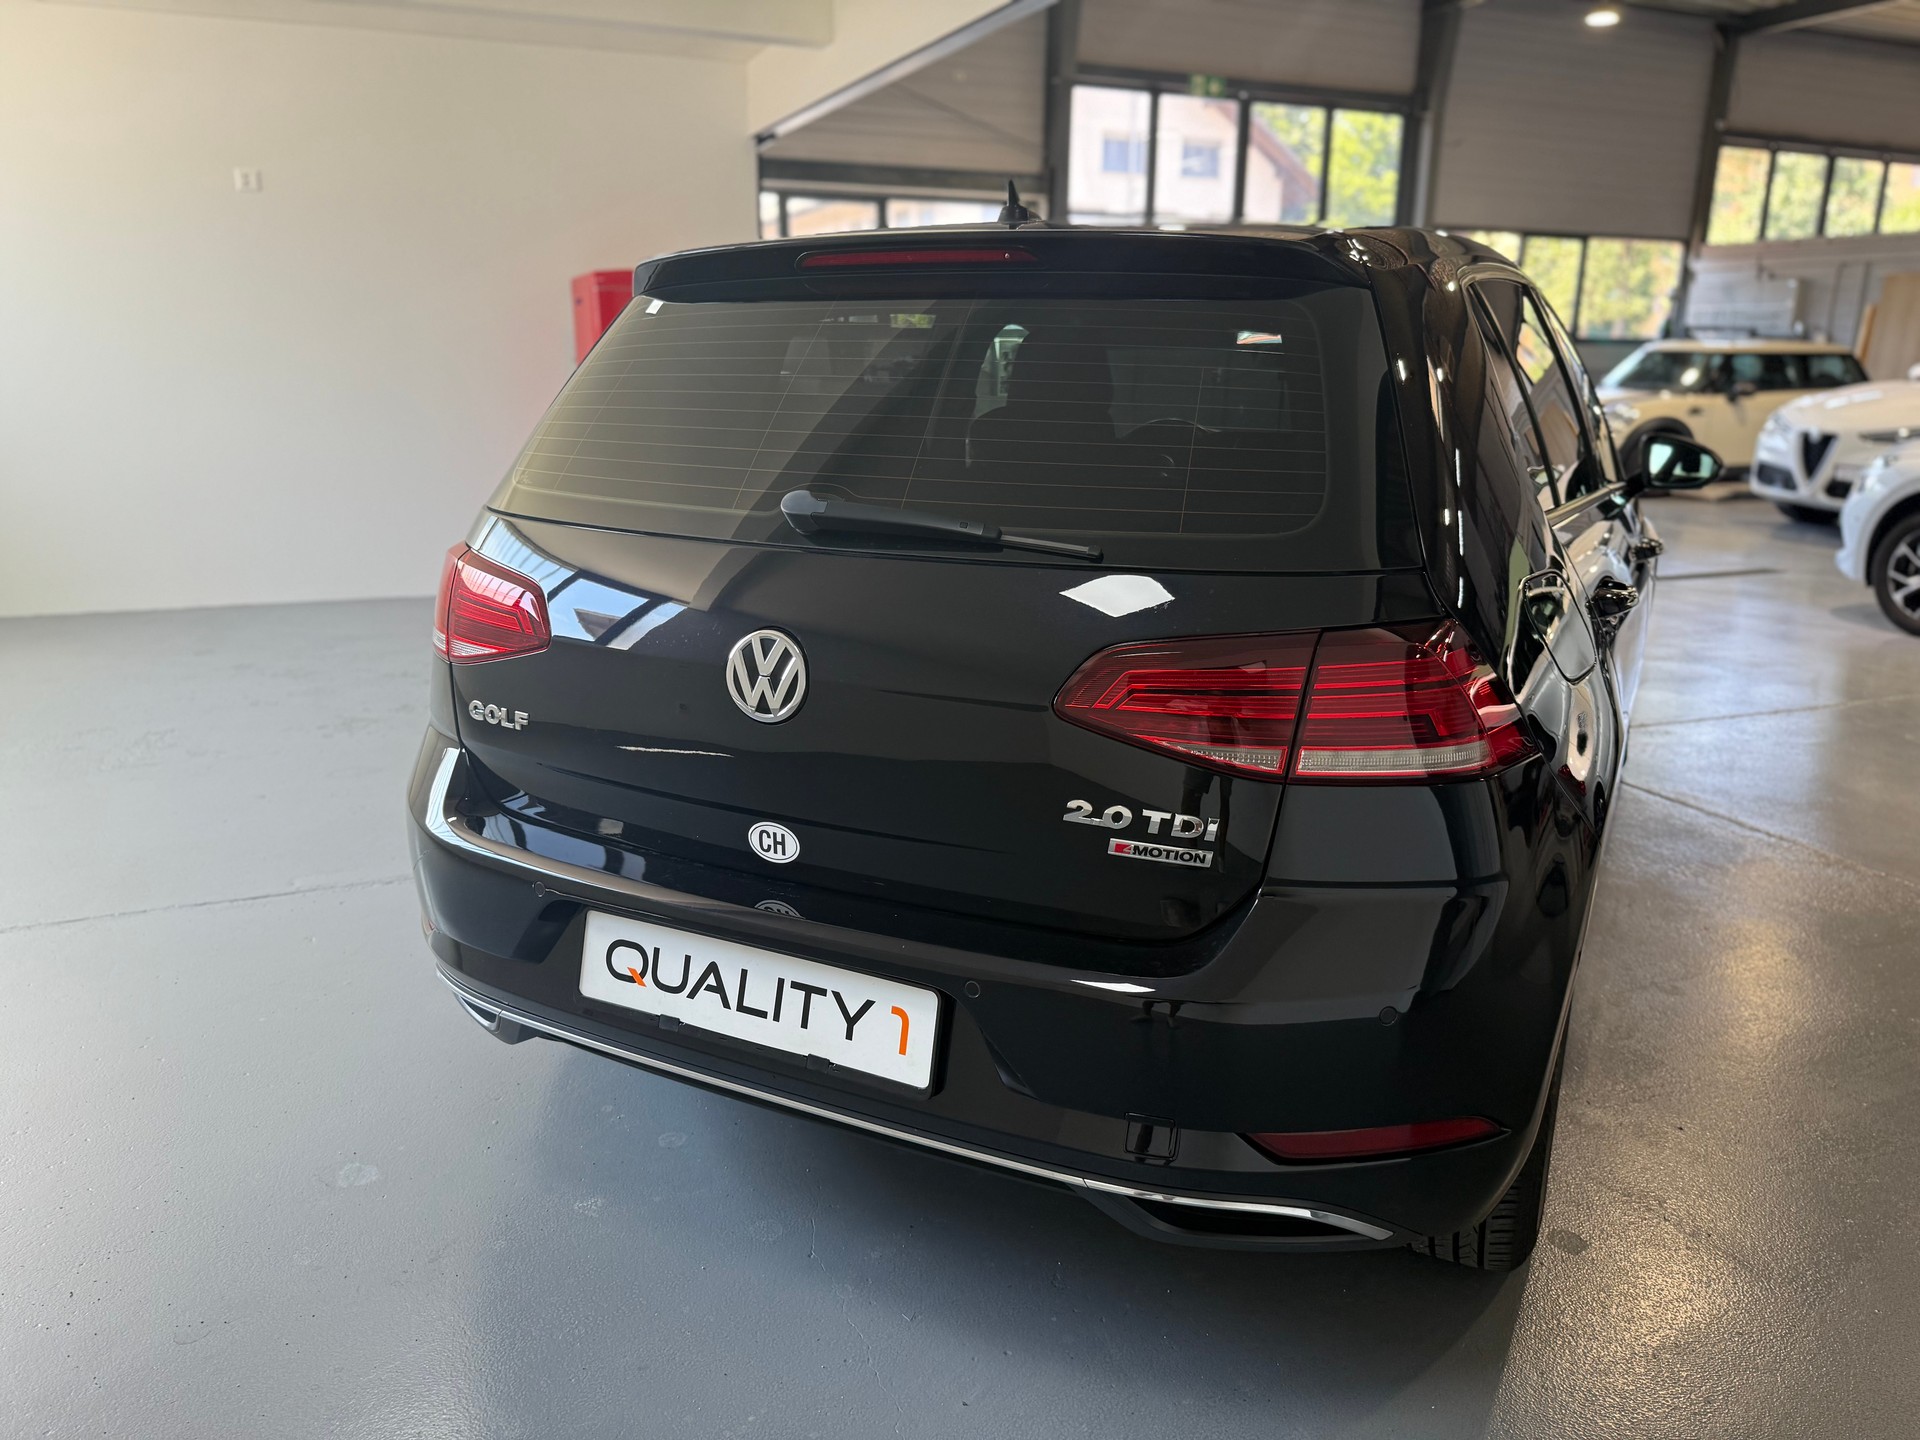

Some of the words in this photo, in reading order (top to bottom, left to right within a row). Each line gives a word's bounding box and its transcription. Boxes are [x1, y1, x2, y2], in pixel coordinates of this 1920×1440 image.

[726, 629, 806, 723] VW
[468, 700, 530, 730] GOLF
[1063, 799, 1133, 830] 2.0
[1142, 808, 1220, 842] TDI
[758, 829, 787, 856] CH
[605, 938, 876, 1041] QUALITY
[890, 1005, 910, 1056] 1
